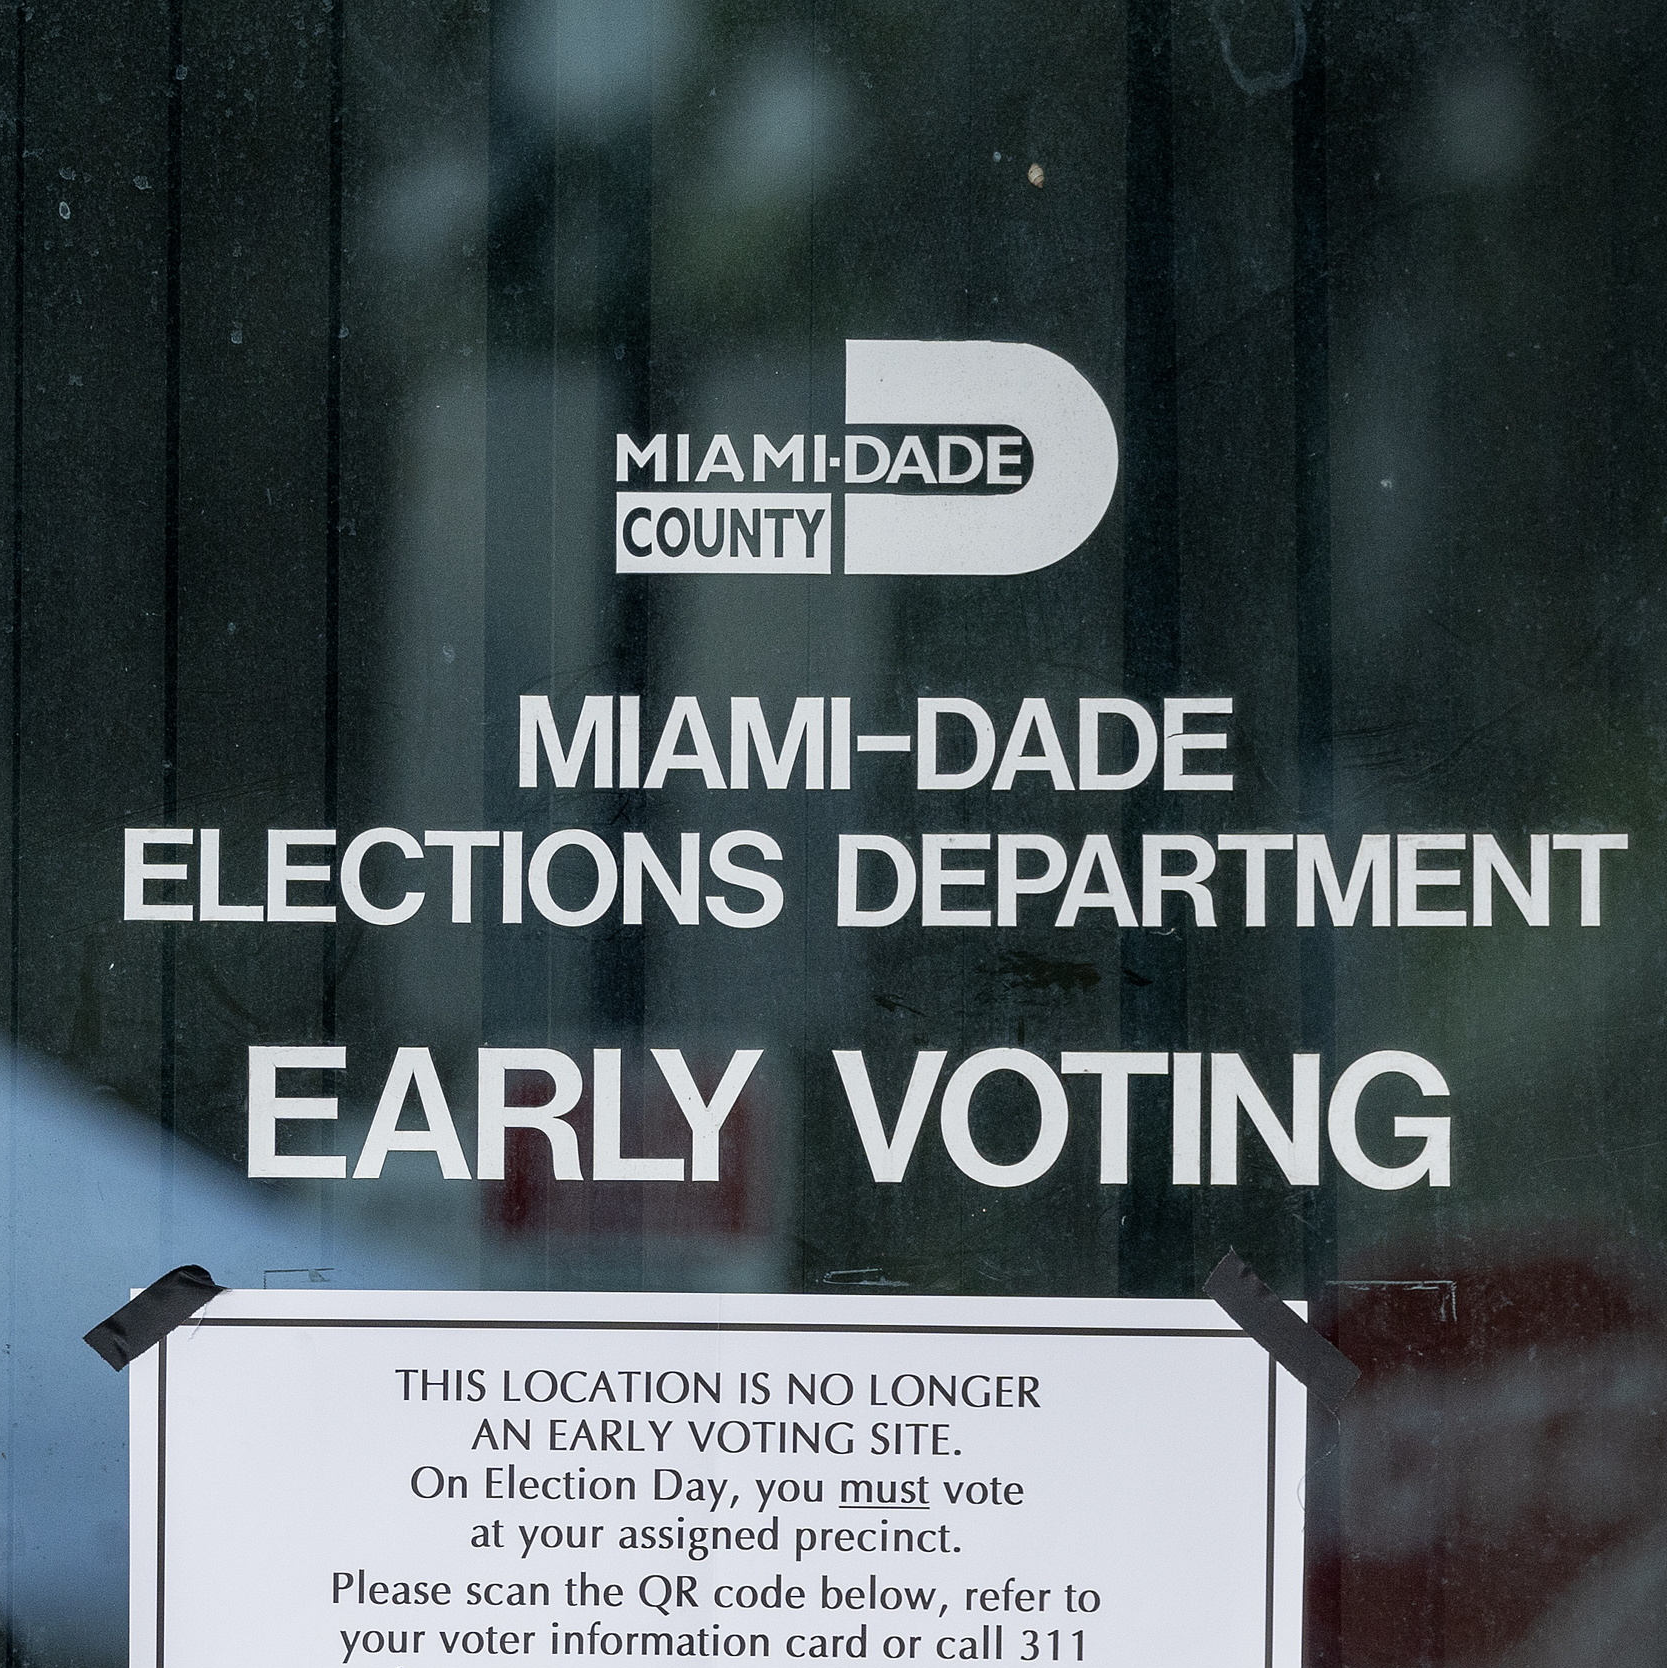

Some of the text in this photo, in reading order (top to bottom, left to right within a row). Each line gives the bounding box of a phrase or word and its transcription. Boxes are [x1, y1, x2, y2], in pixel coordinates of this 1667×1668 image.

[616, 433, 1023, 484] MIAMI-DADE
[622, 506, 826, 558] COUNTY
[519, 695, 1233, 790] MIAMI-DADE
[124, 827, 1628, 928] ELECTIONS DEPARTMENT
[248, 1046, 1451, 1190] EARLY VOTING
[395, 1369, 1041, 1407] THIS LOCATION IS NO LONGER
[471, 1516, 960, 1561] at your assigned precinct.
[340, 1621, 1083, 1664] your voter information card or call 311
